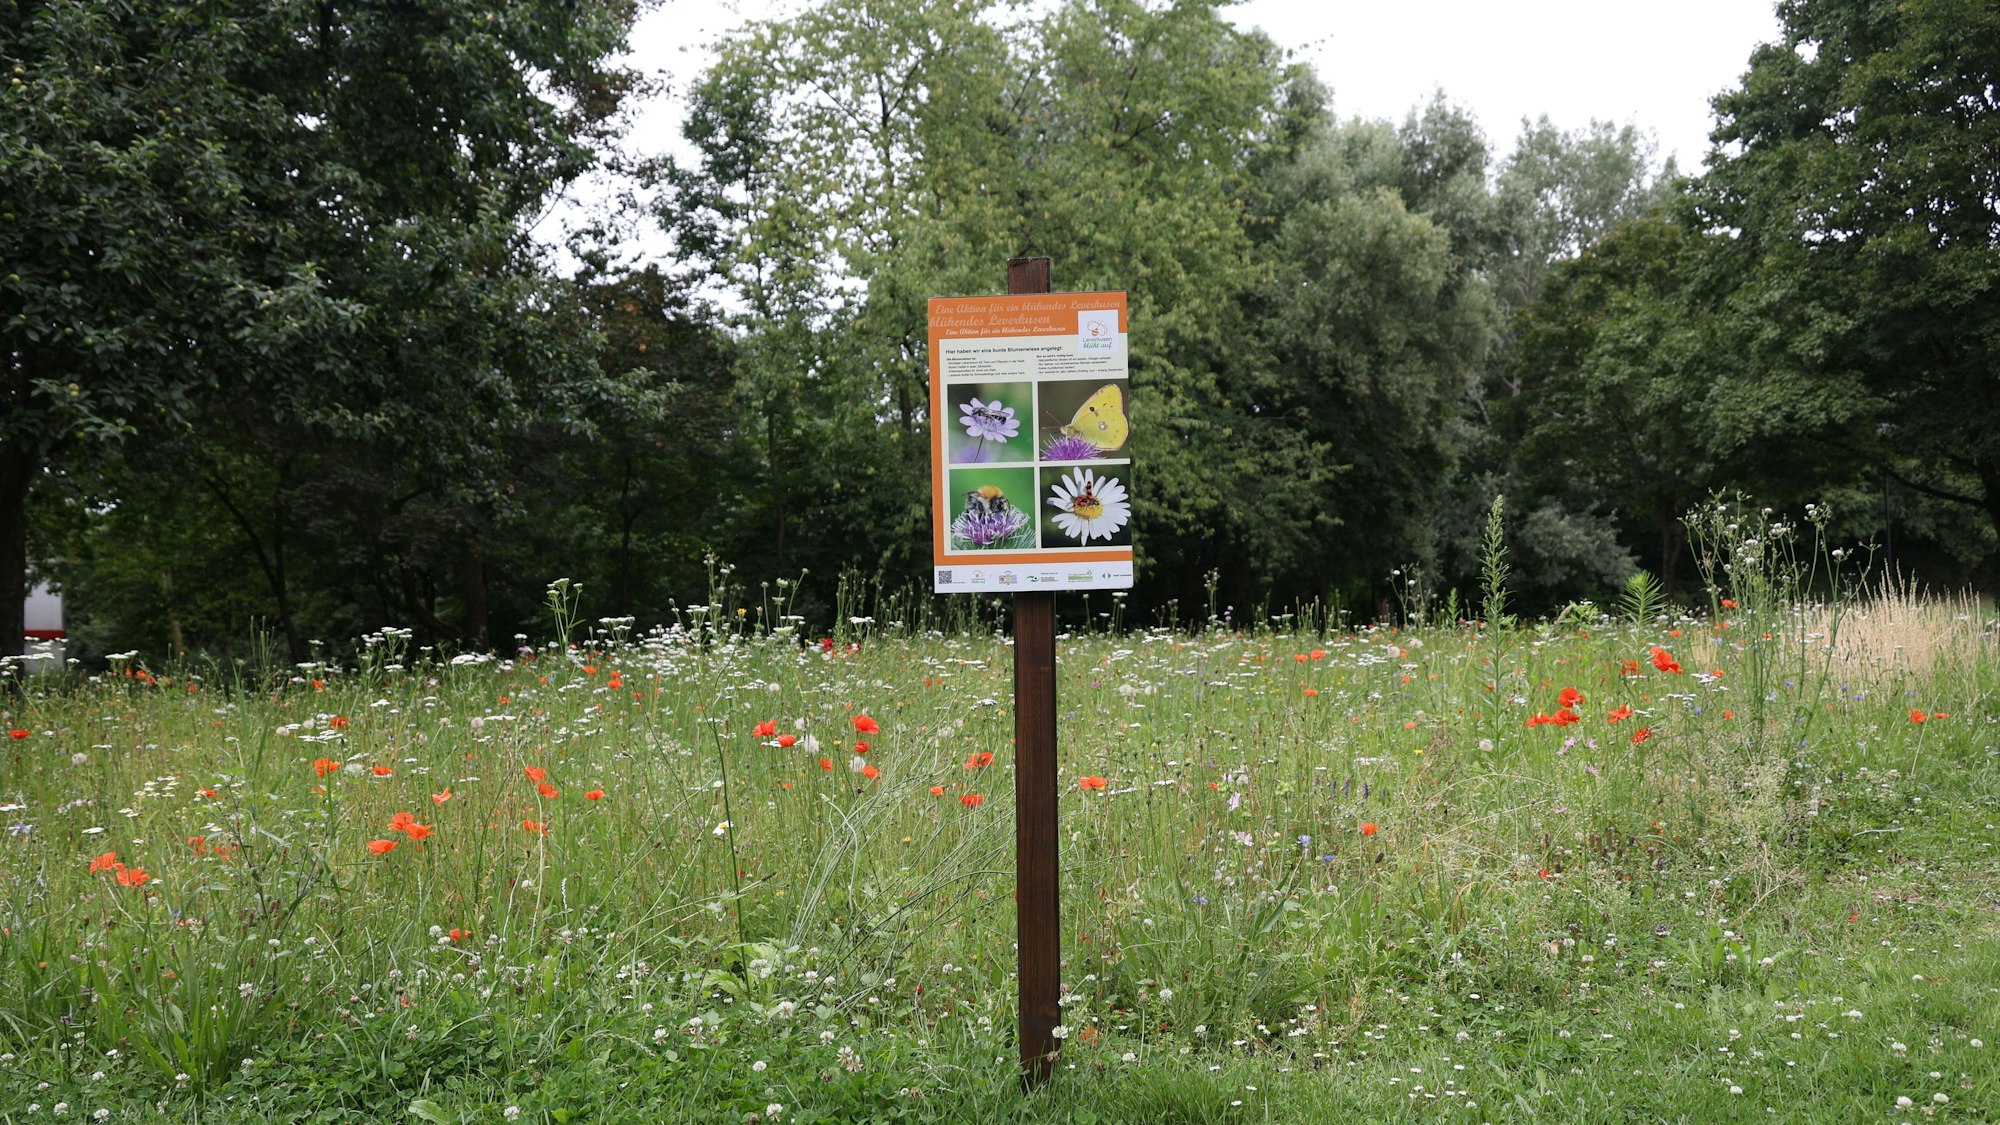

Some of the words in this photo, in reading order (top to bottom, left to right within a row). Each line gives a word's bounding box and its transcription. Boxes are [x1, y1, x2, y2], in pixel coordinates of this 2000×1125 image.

[936, 305, 954, 314] Eine
[956, 303, 986, 313] Aktion
[989, 303, 1004, 314] für
[1006, 303, 1019, 312] ein
[1021, 302, 1067, 311] blühendes
[1070, 300, 1121, 309] Leverkusen
[929, 315, 984, 327] blühendes
[988, 313, 1051, 325] Leverkusen
[1083, 341, 1099, 349] blüht
